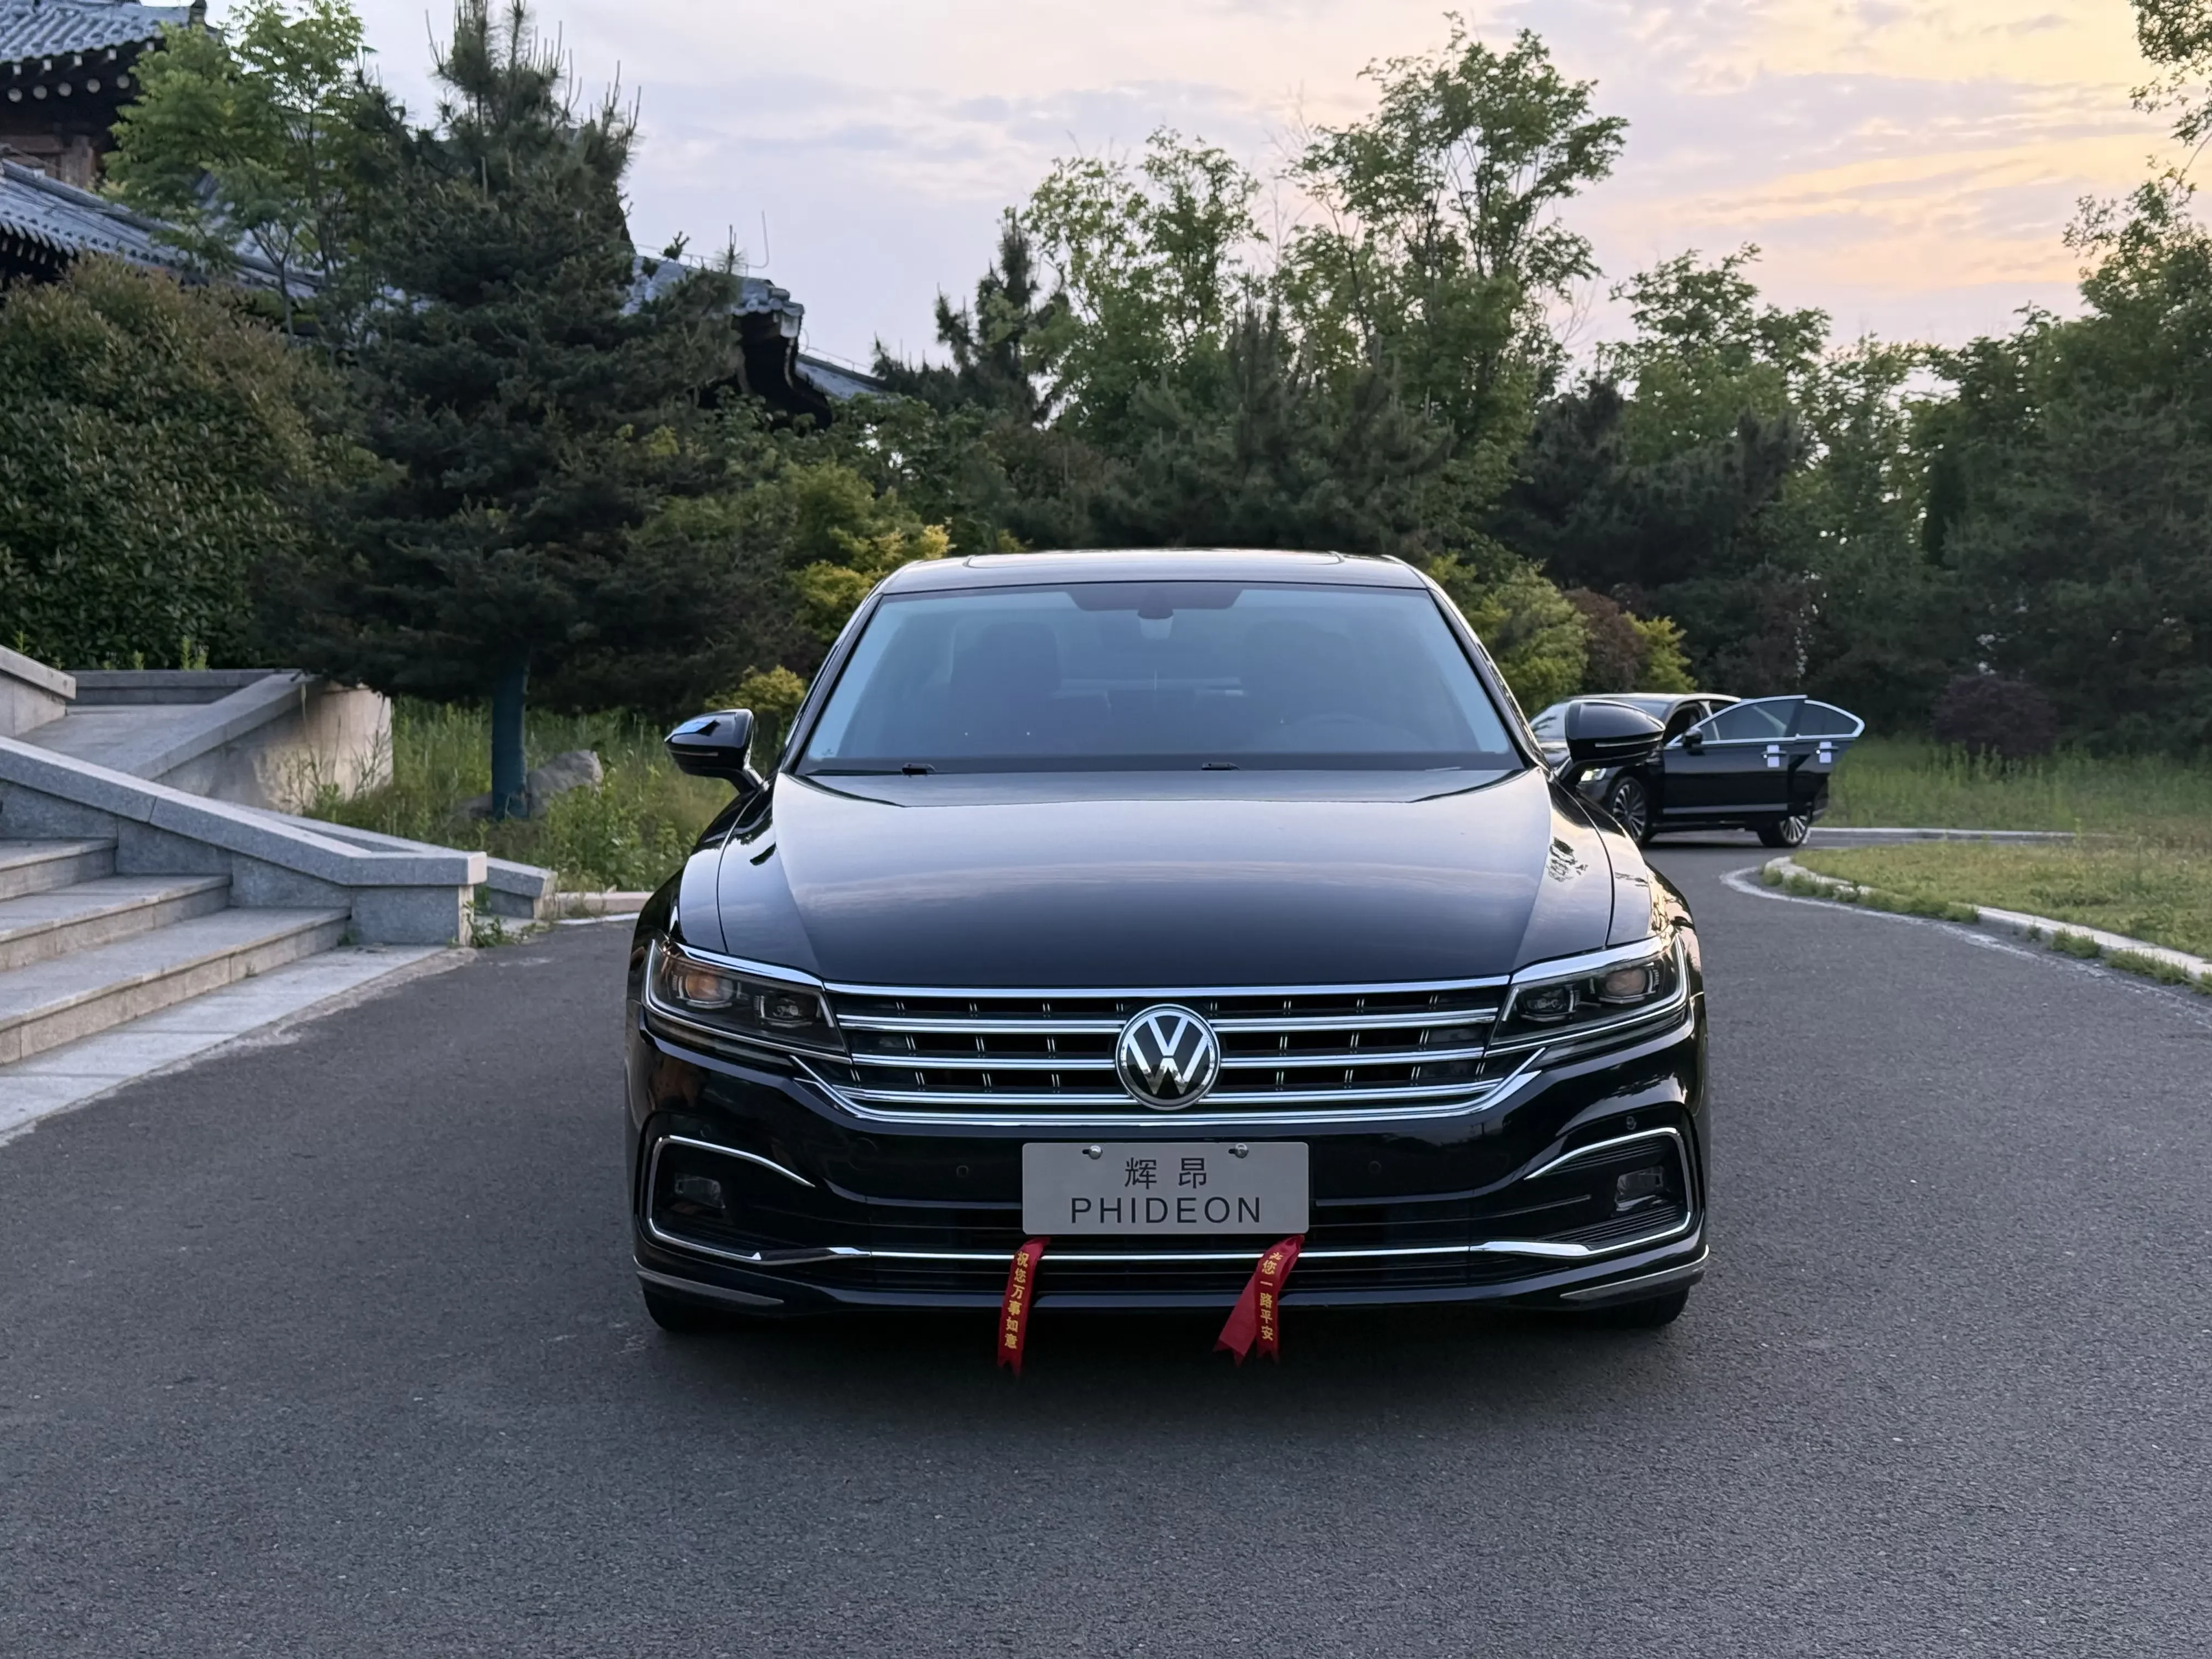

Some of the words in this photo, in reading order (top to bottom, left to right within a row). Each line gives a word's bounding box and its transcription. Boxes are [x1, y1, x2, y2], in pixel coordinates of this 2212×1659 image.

[1124, 1157, 1207, 1189] 辉昂
[1071, 1197, 1260, 1224] PHIDEON
[1005, 1251, 1030, 1349] 祝您万事如意
